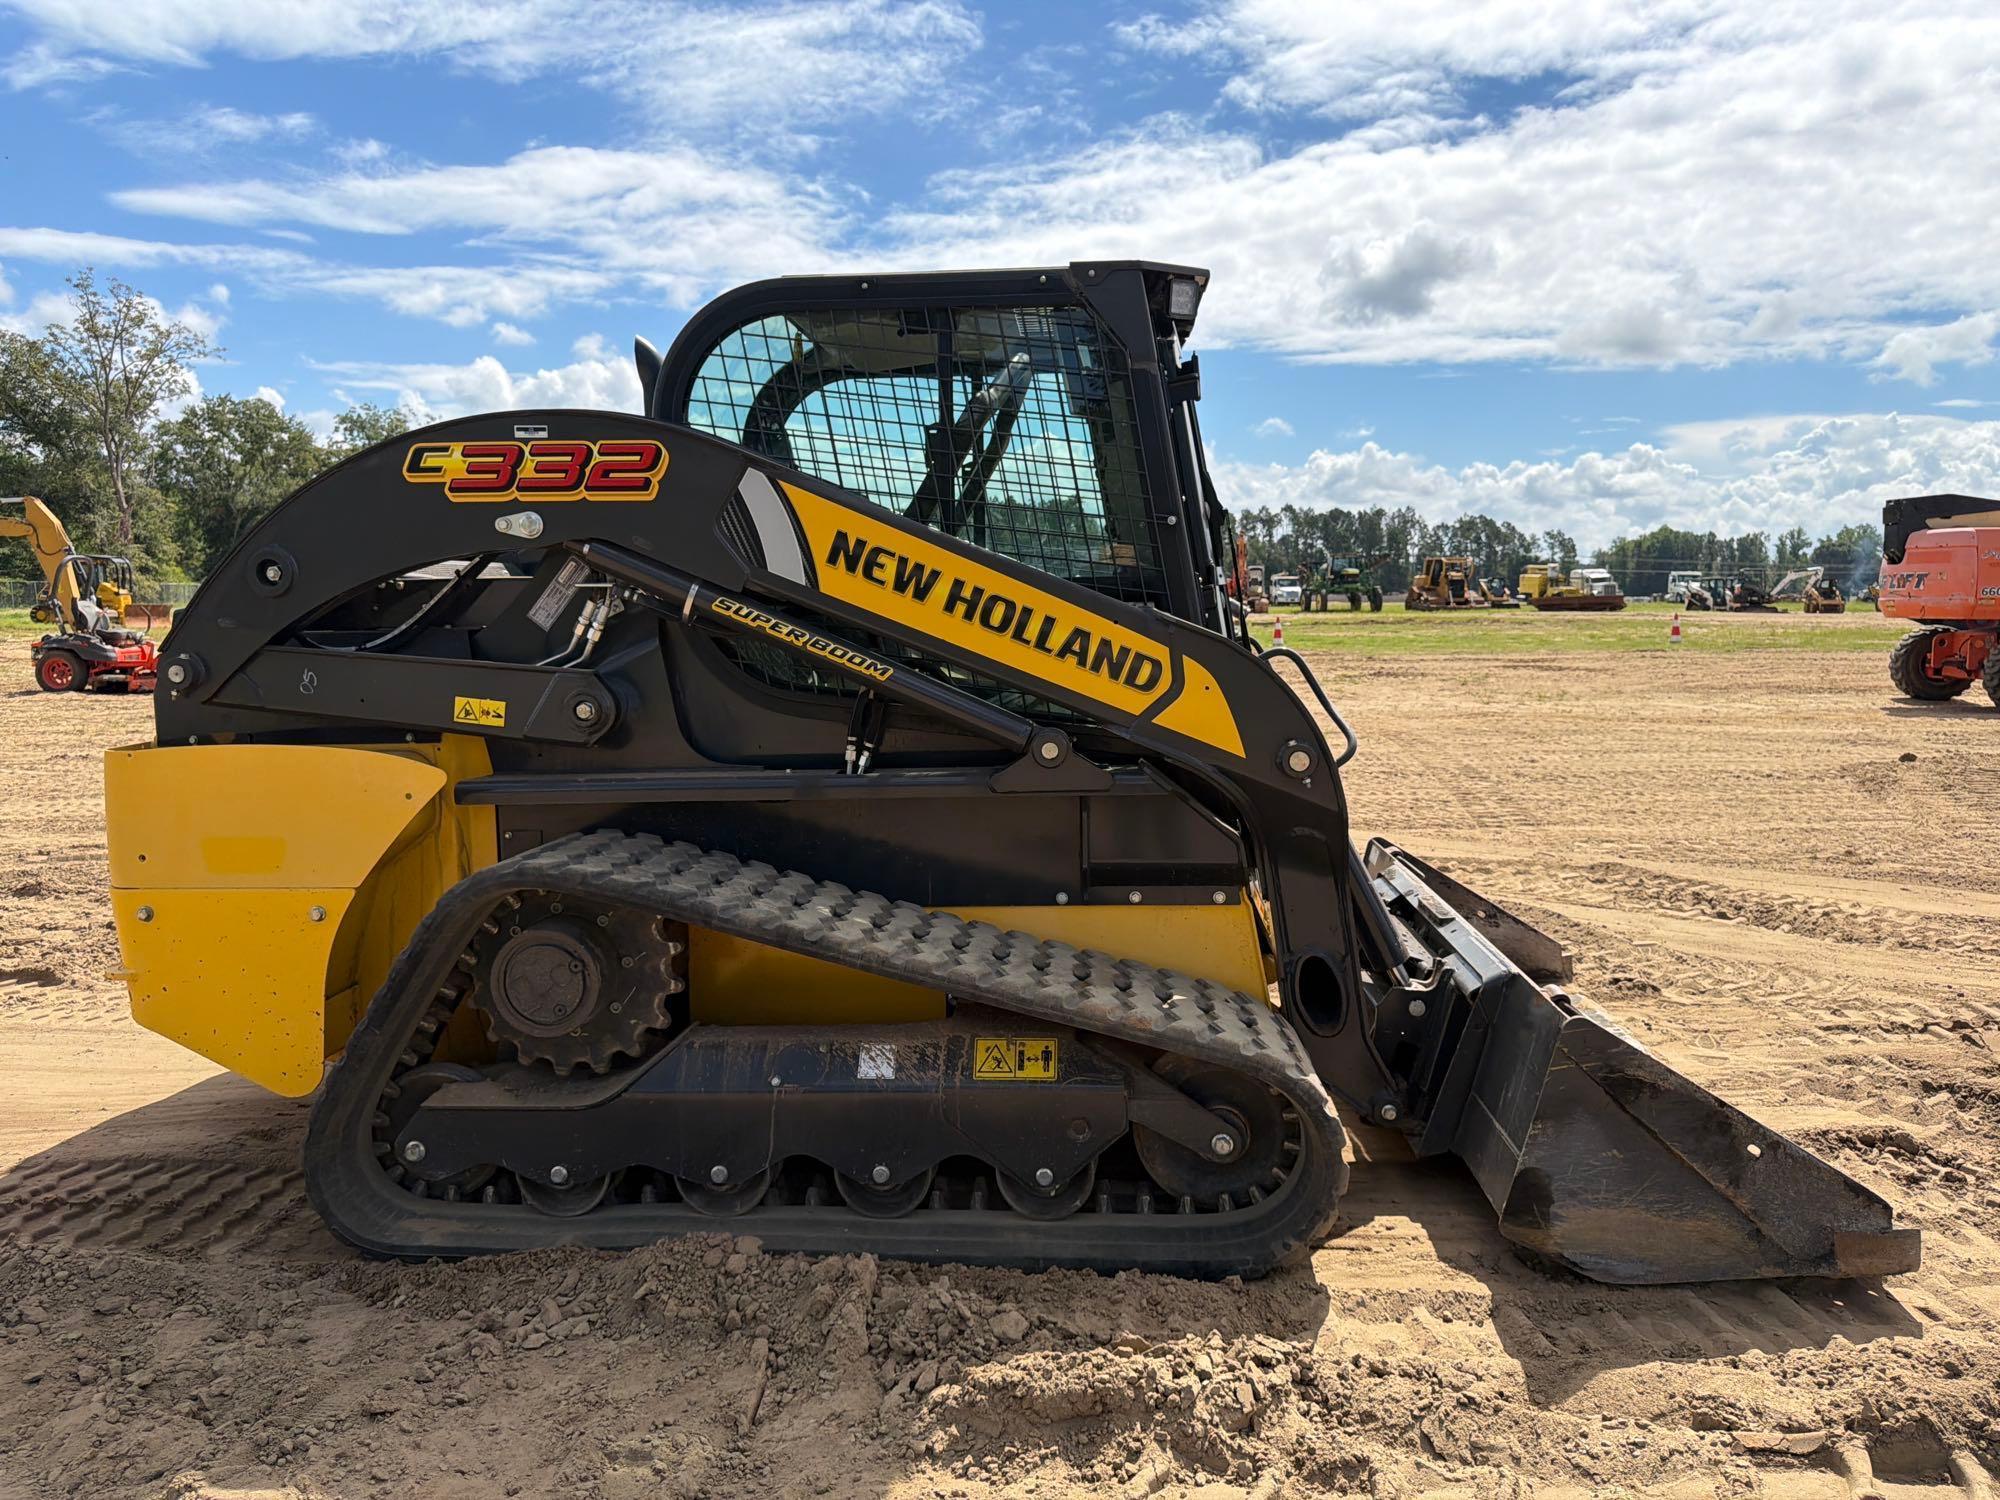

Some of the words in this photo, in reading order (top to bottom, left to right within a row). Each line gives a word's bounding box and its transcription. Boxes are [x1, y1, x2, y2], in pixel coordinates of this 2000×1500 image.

[404, 441, 668, 500] C332
[712, 597, 809, 647] SUPER
[807, 636, 895, 682] BOOM
[825, 528, 943, 604] NEW
[942, 576, 1164, 695] HOLLAND
